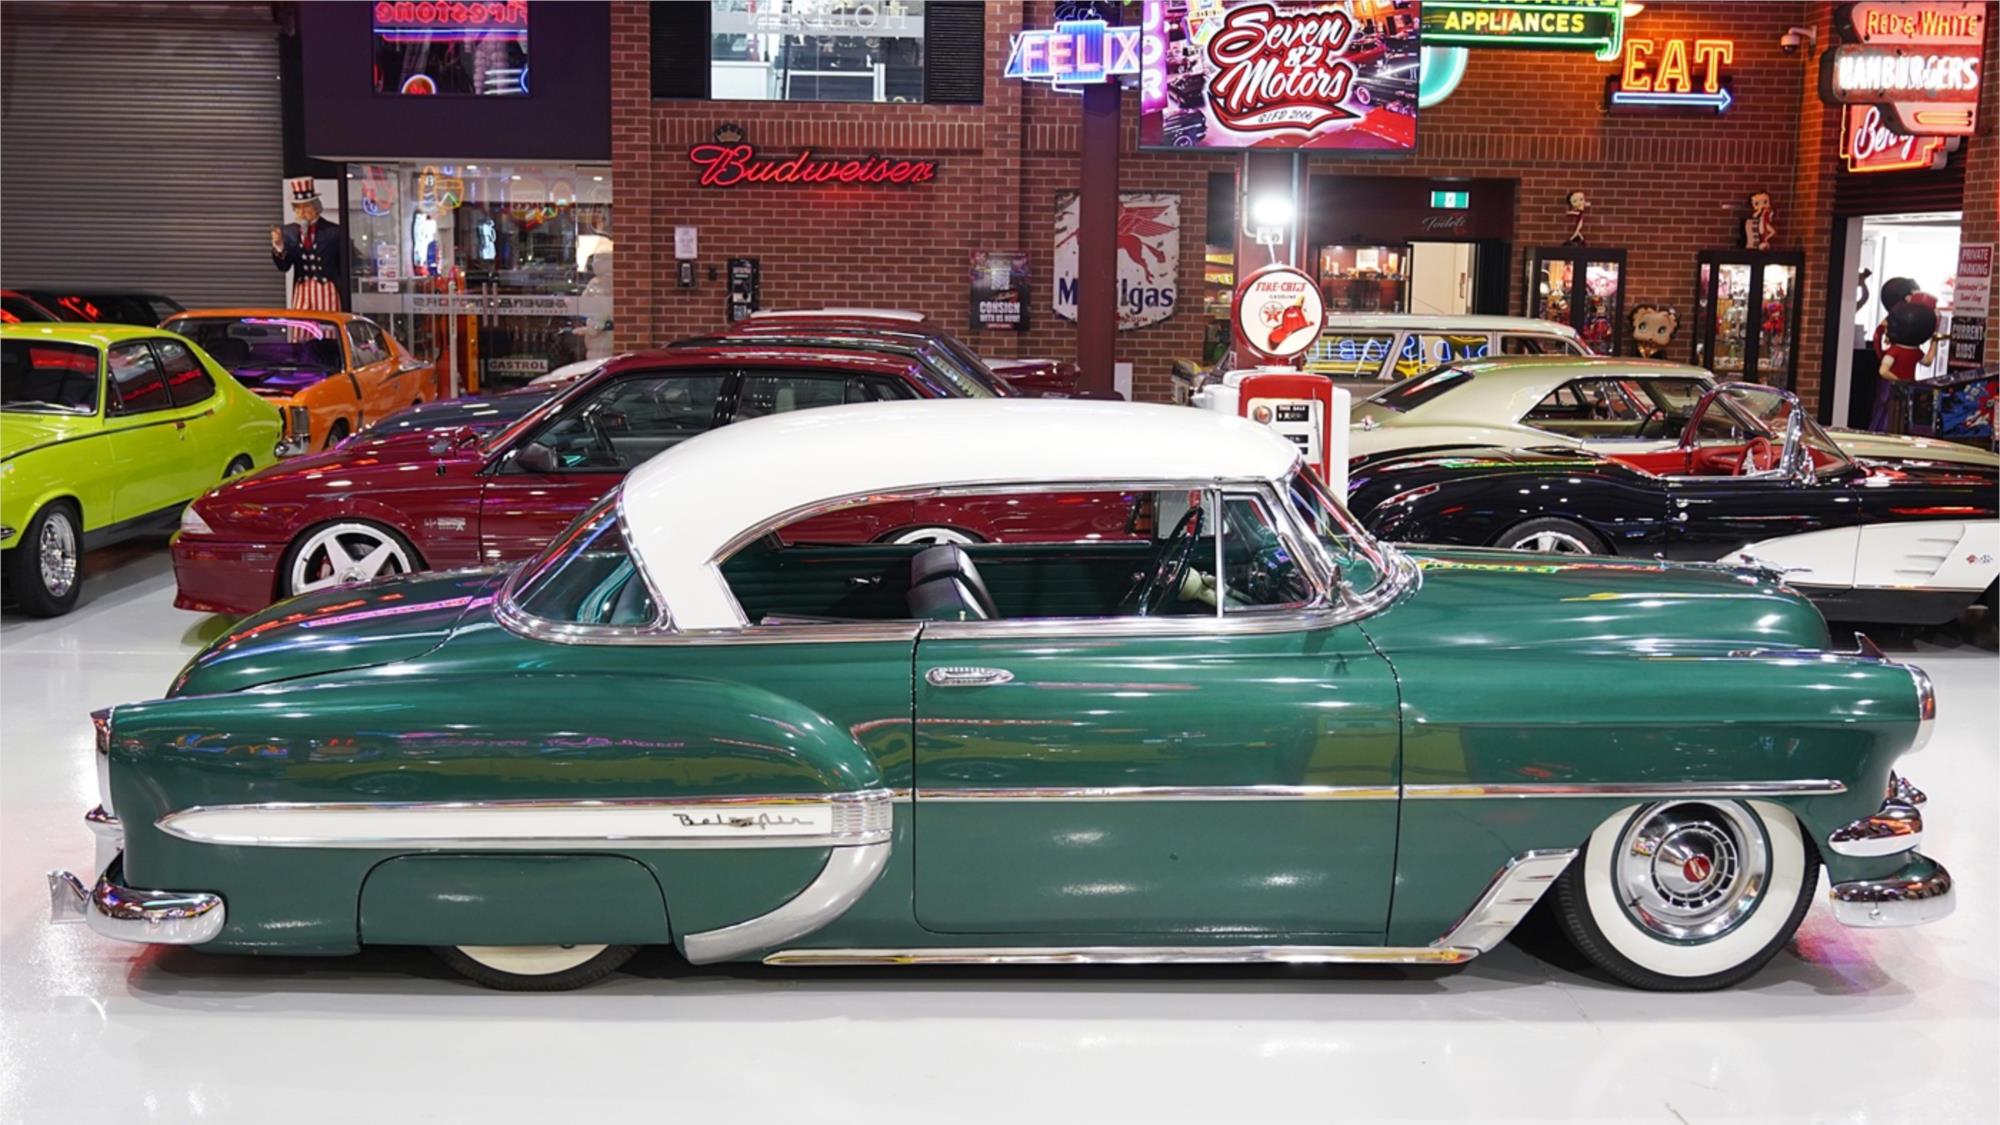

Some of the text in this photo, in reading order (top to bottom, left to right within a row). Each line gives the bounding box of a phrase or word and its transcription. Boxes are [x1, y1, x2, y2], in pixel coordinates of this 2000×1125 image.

[1214, 11, 1344, 64] Seven
[1445, 11, 1585, 33] APPLIANCES
[1868, 10, 1899, 33] RED
[1918, 10, 1977, 37] WHITE
[1023, 32, 1141, 73] FELIX
[1621, 39, 1733, 93] EAT
[1215, 58, 1347, 110] Motors
[1838, 55, 1980, 91] HAMBURGERS
[690, 145, 934, 187] Budweiser
[979, 301, 1020, 314] CONSIGN
[1058, 277, 1174, 315] Mlgas
[489, 361, 547, 370] CASTROL
[673, 812, 814, 830] Bel Air
